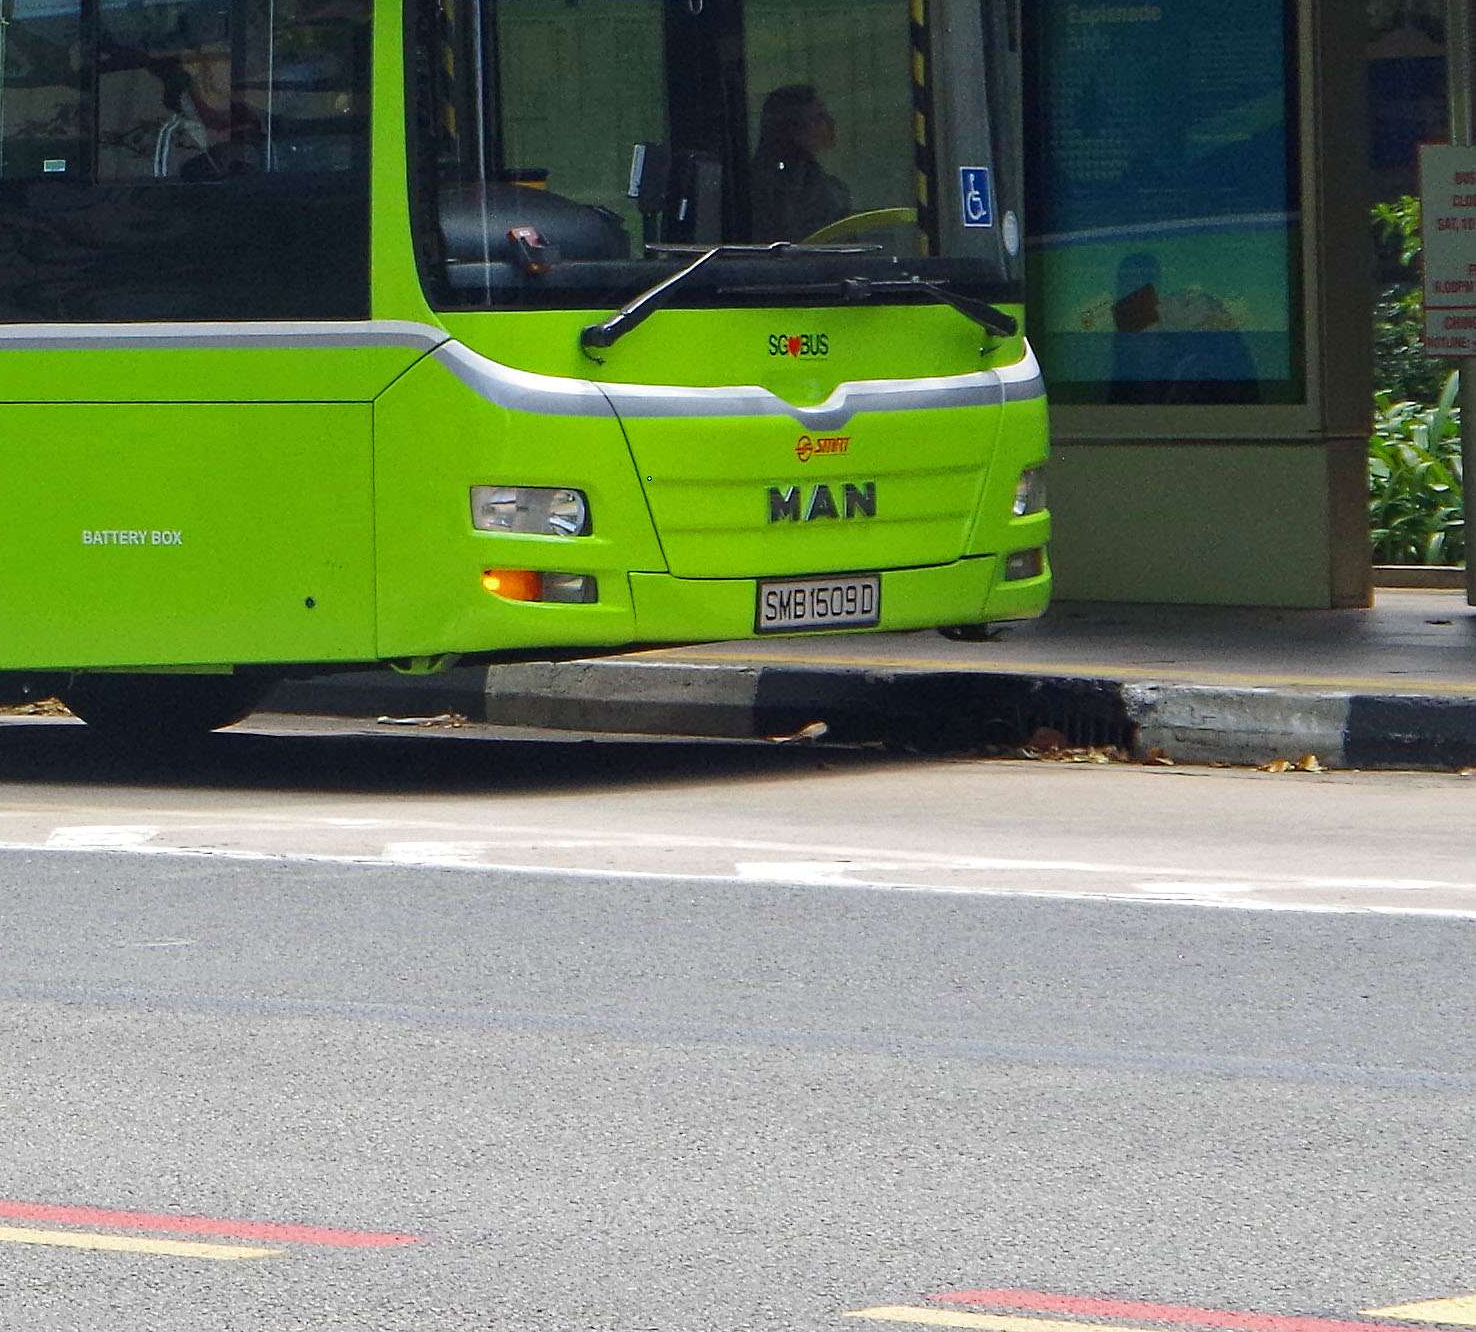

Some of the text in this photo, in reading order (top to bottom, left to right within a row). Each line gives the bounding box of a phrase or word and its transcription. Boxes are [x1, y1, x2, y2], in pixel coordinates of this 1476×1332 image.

[814, 437, 851, 452] SMRT
[769, 481, 876, 523] MAN
[82, 530, 183, 545] BATTERY BOX
[765, 584, 874, 622] SMB1509D
